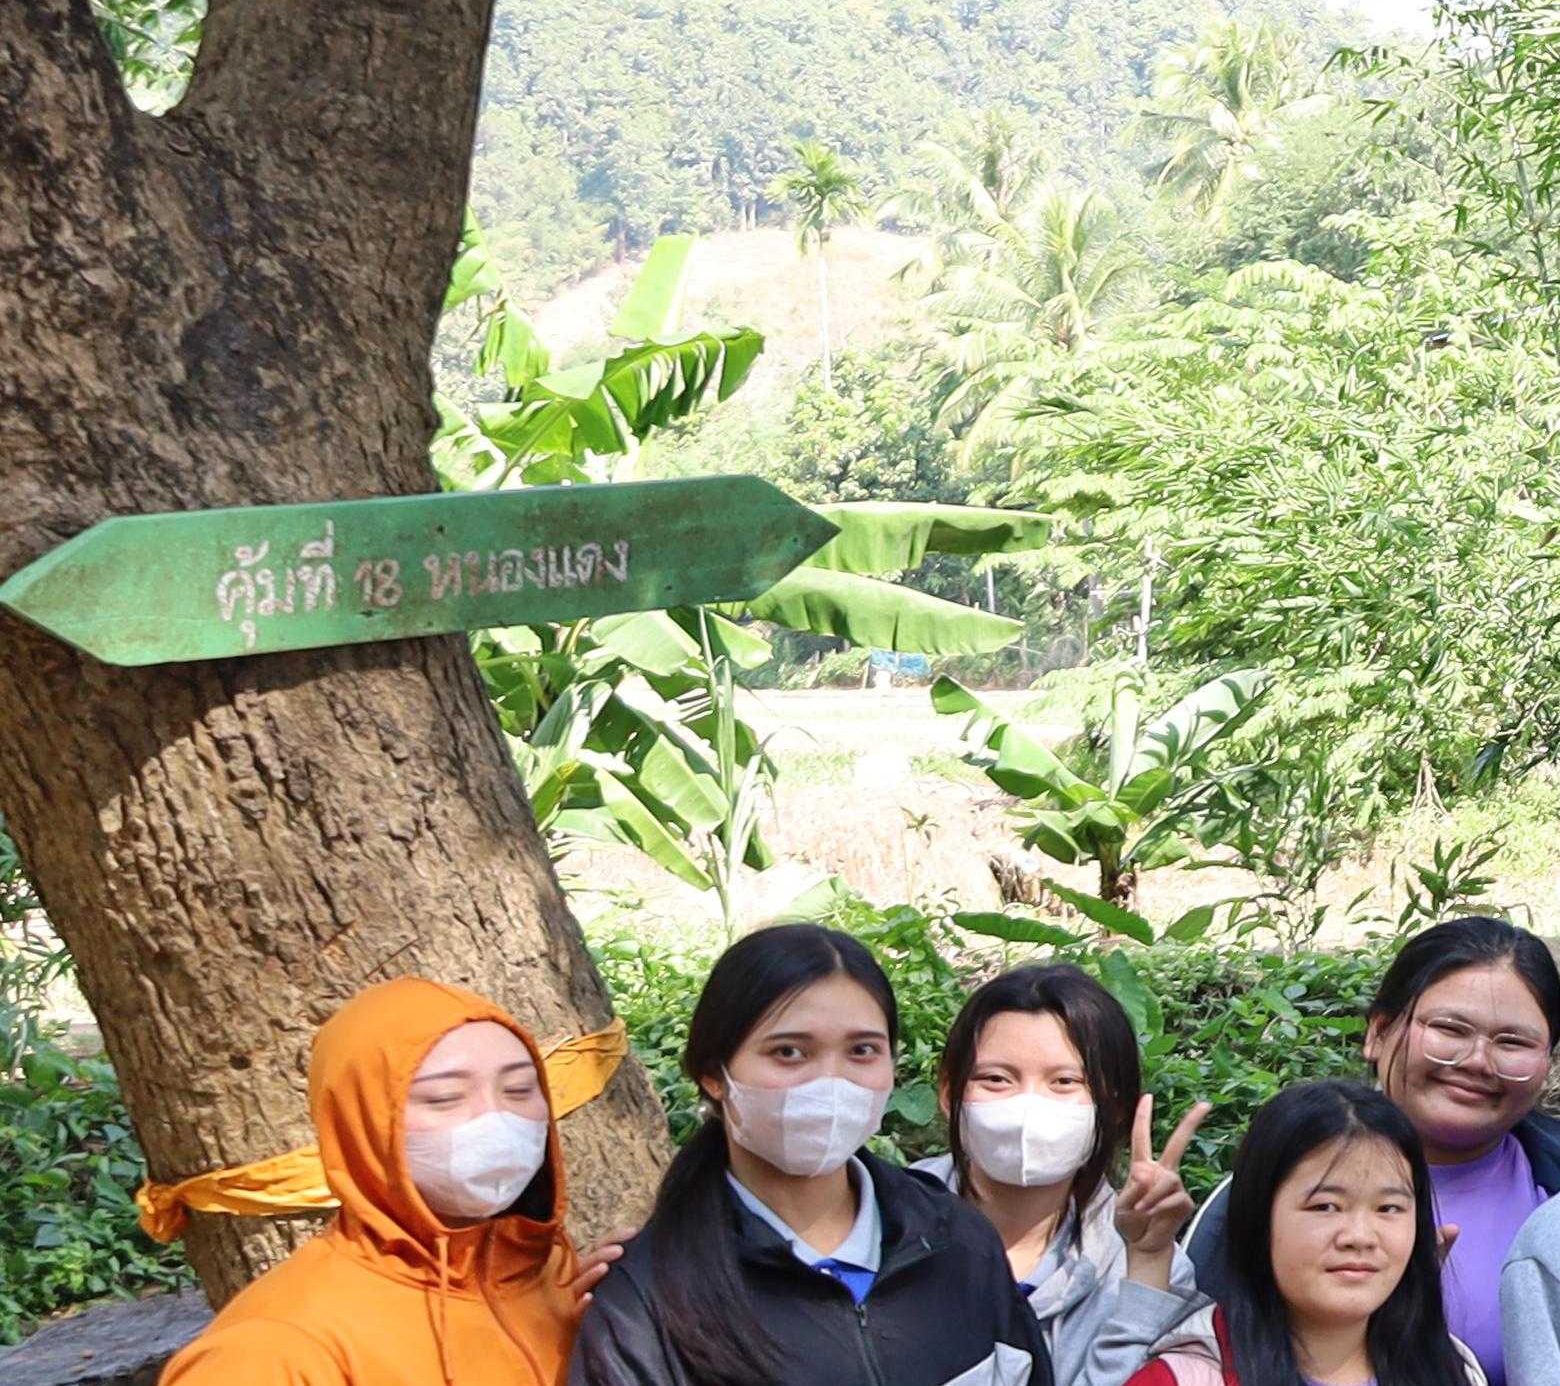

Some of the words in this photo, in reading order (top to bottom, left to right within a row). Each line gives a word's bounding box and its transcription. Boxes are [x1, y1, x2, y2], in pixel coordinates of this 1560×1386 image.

[214, 519, 336, 649] คุ้มที่
[353, 558, 401, 607] 18
[423, 539, 630, 600] หนองแดง
